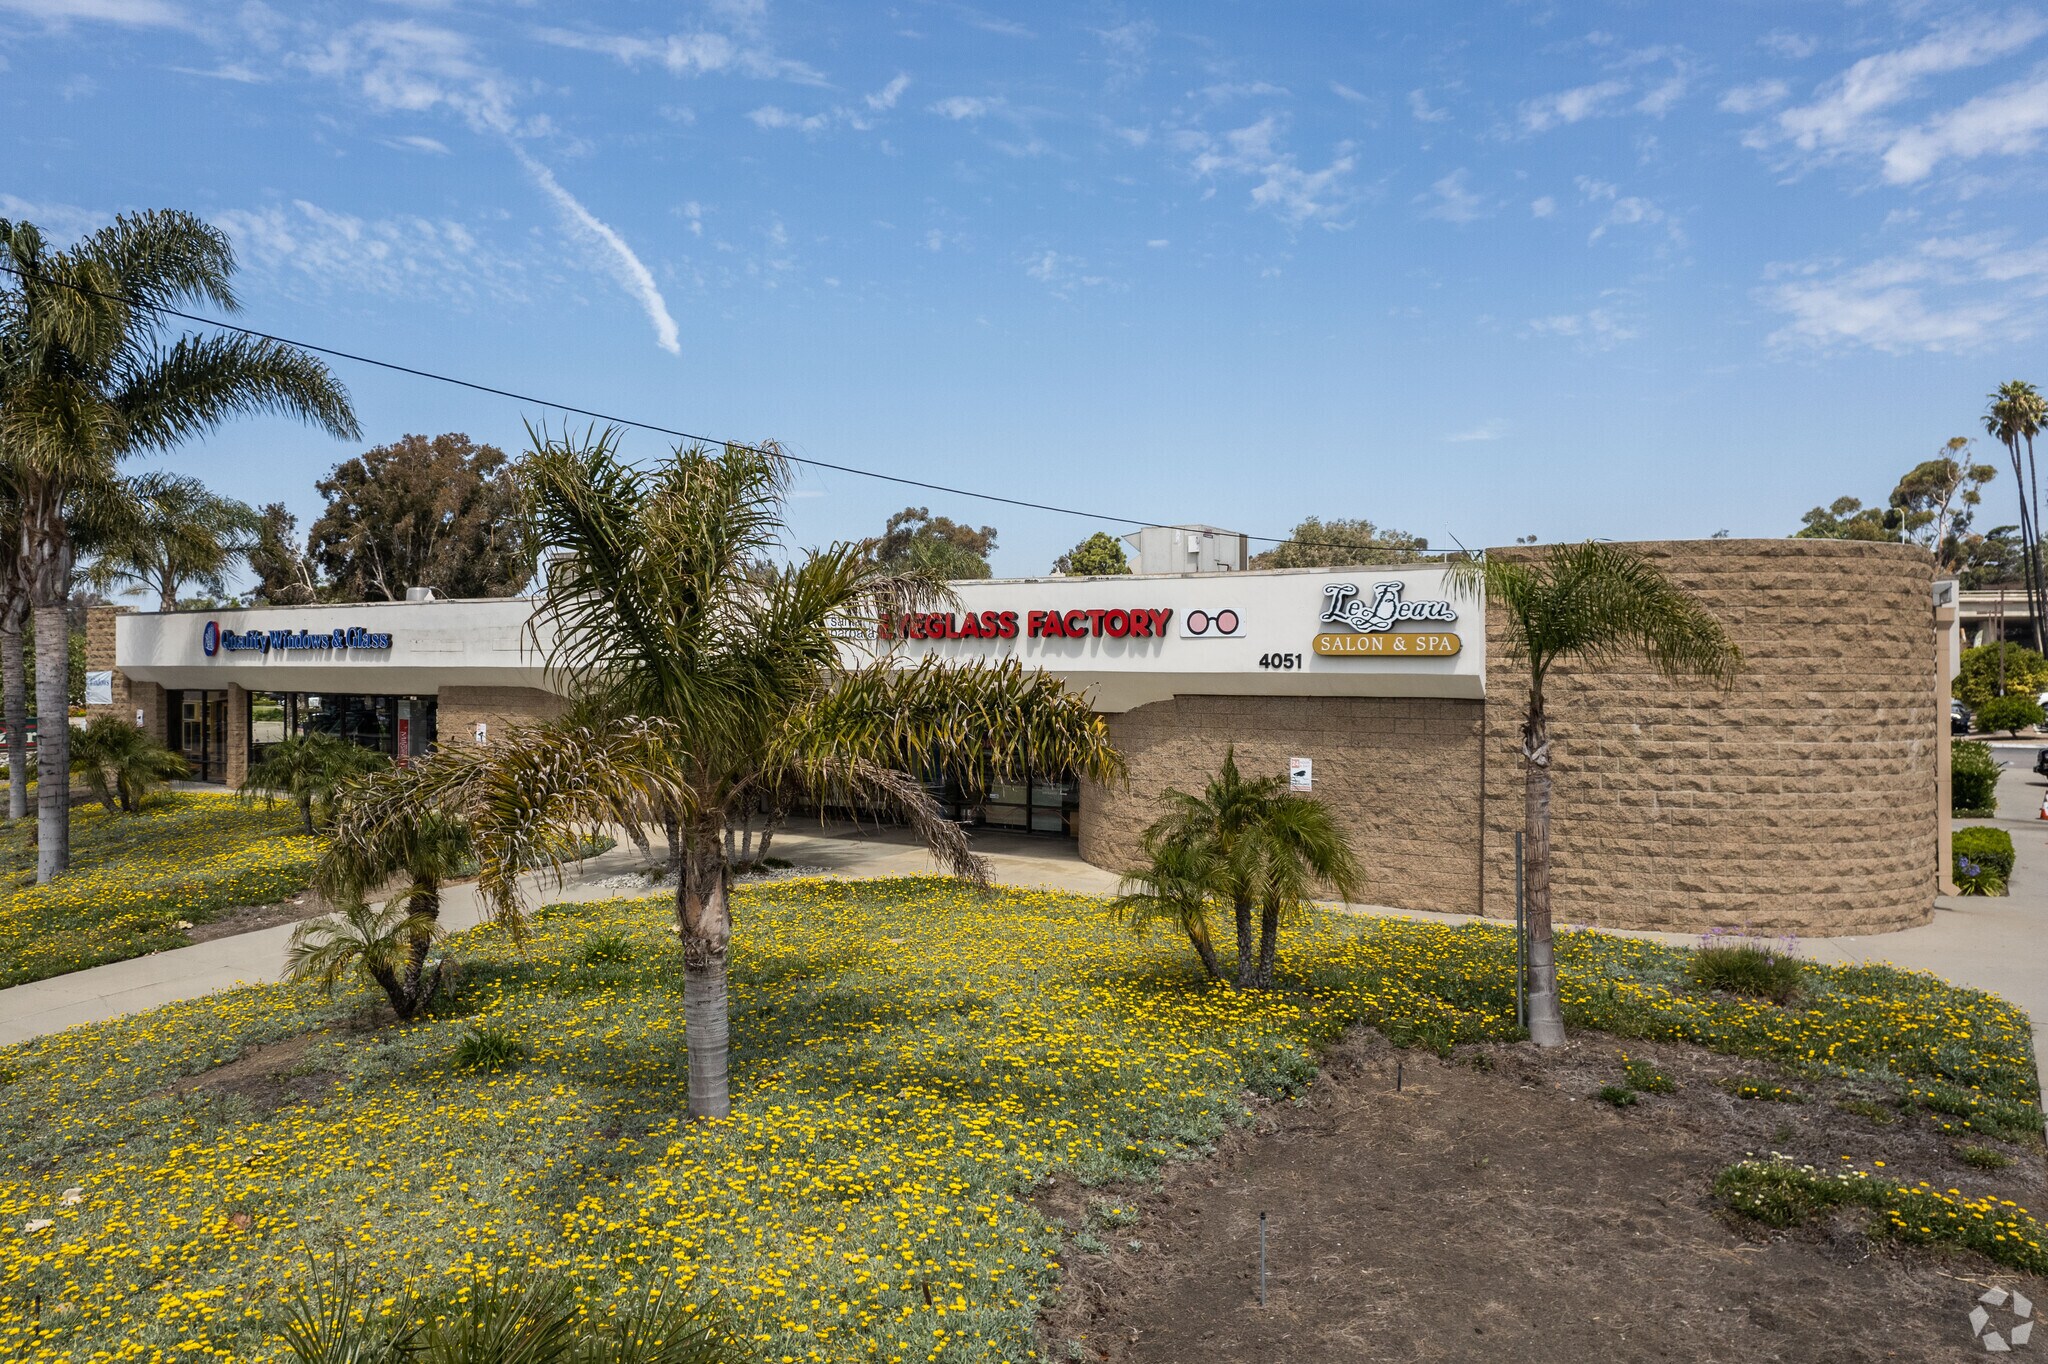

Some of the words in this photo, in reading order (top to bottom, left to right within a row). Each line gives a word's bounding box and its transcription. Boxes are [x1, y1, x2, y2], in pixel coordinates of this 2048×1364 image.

[1322, 583, 1360, 620] Le
[1351, 583, 1453, 630] Beau
[830, 627, 875, 638] barbaa
[1027, 608, 1168, 638] FACTORY
[221, 629, 268, 654] Quality
[268, 629, 328, 650] Windows
[332, 628, 345, 649] &
[346, 626, 389, 649] Glass
[1321, 636, 1383, 651] SALON
[1393, 636, 1407, 651] &
[1416, 636, 1453, 651] SPA
[1259, 653, 1302, 669] 4051
